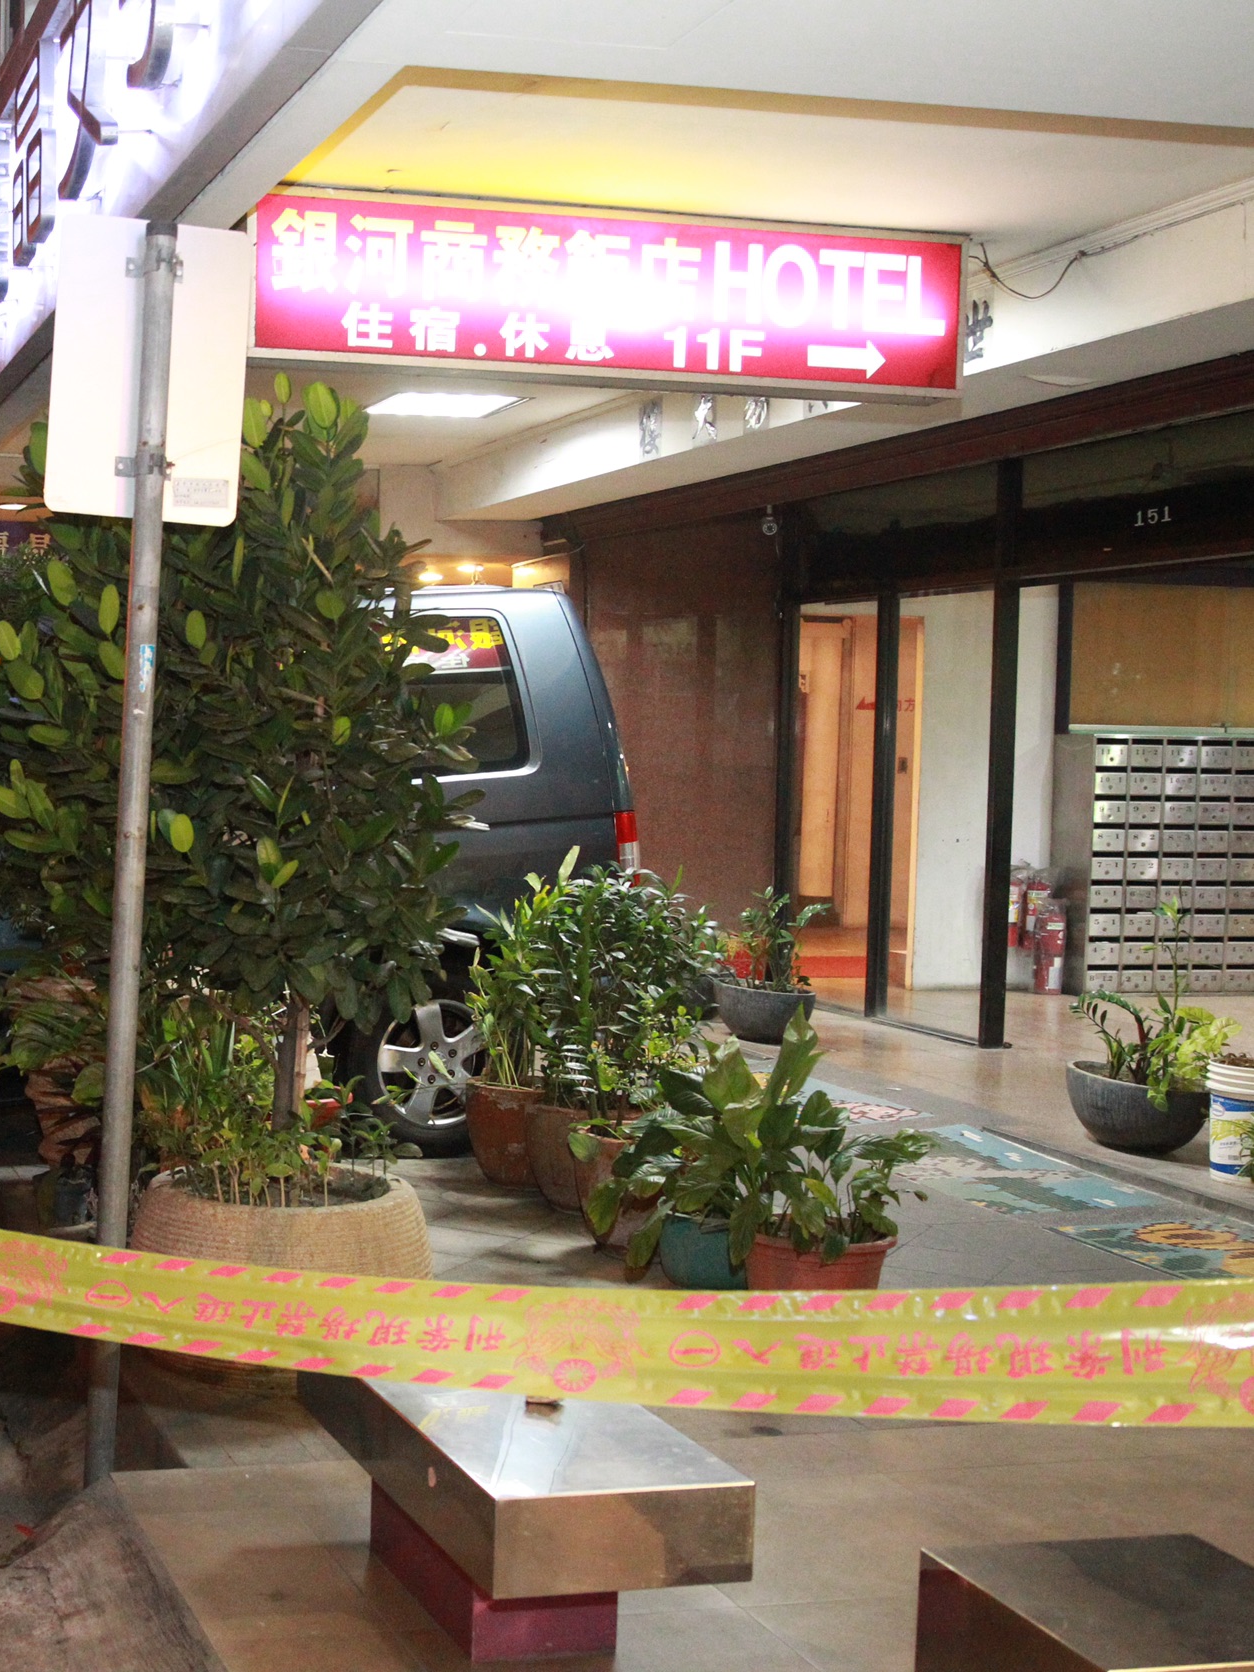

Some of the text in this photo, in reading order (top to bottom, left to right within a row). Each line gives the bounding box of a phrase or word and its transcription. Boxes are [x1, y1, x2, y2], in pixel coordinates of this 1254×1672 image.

[712, 241, 946, 337] HOTEL
[663, 326, 766, 373] 11F
[1134, 505, 1172, 527] 151
[142, 1291, 507, 1352] 刑案現場禁止進入
[732, 1327, 1169, 1380] 刑案現場禁止進入
